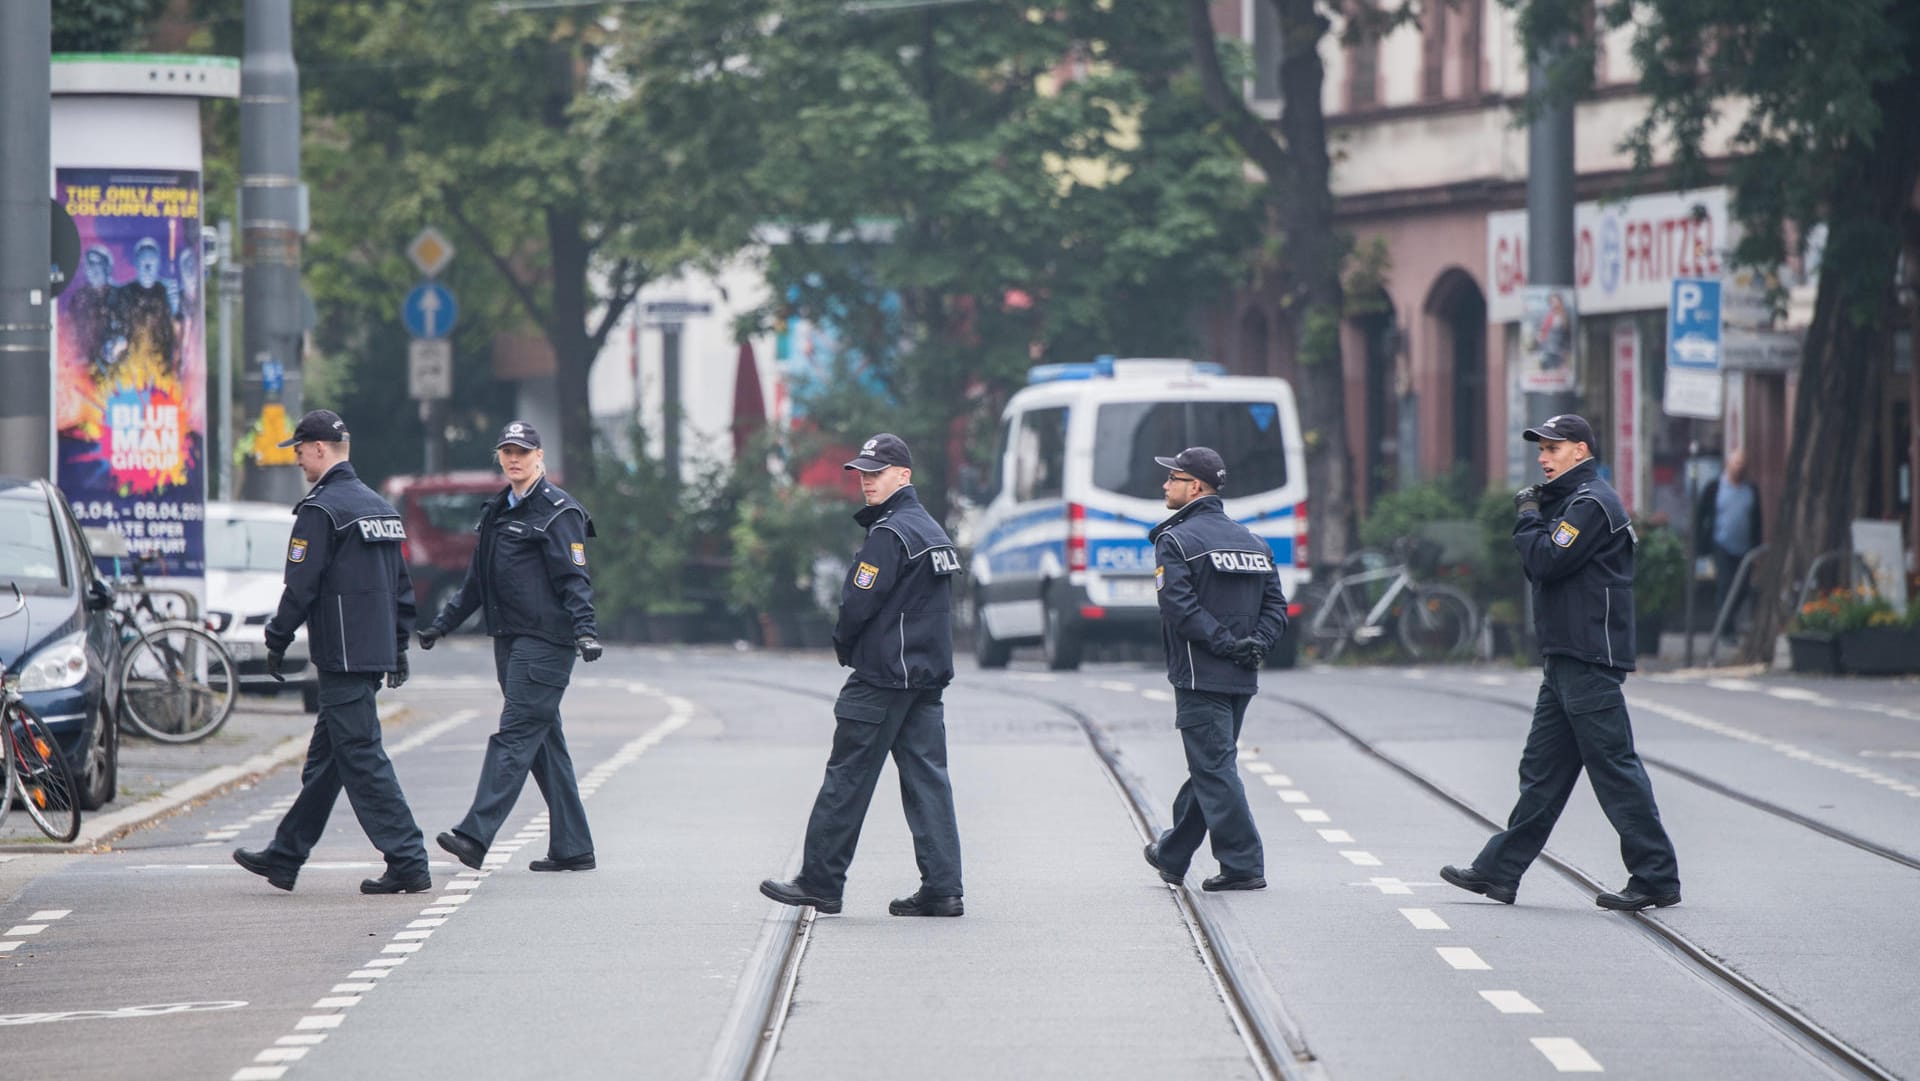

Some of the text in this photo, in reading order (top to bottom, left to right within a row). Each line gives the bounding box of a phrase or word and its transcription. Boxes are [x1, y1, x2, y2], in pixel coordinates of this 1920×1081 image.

[67, 186, 101, 202] THE
[106, 186, 147, 202] ONLY
[151, 187, 187, 203] SHOW
[66, 201, 160, 216] COLOURFUL
[1626, 214, 1720, 284] FRITZEL
[1677, 284, 1702, 325] P
[112, 404, 178, 427] BLUE
[112, 427, 178, 452] MAN
[112, 452, 178, 470] GROUP
[106, 521, 184, 537] ALTE OPER
[125, 538, 186, 553] ANKFURT
[931, 550, 961, 572] POLI
[1211, 552, 1273, 572] POLIZEI
